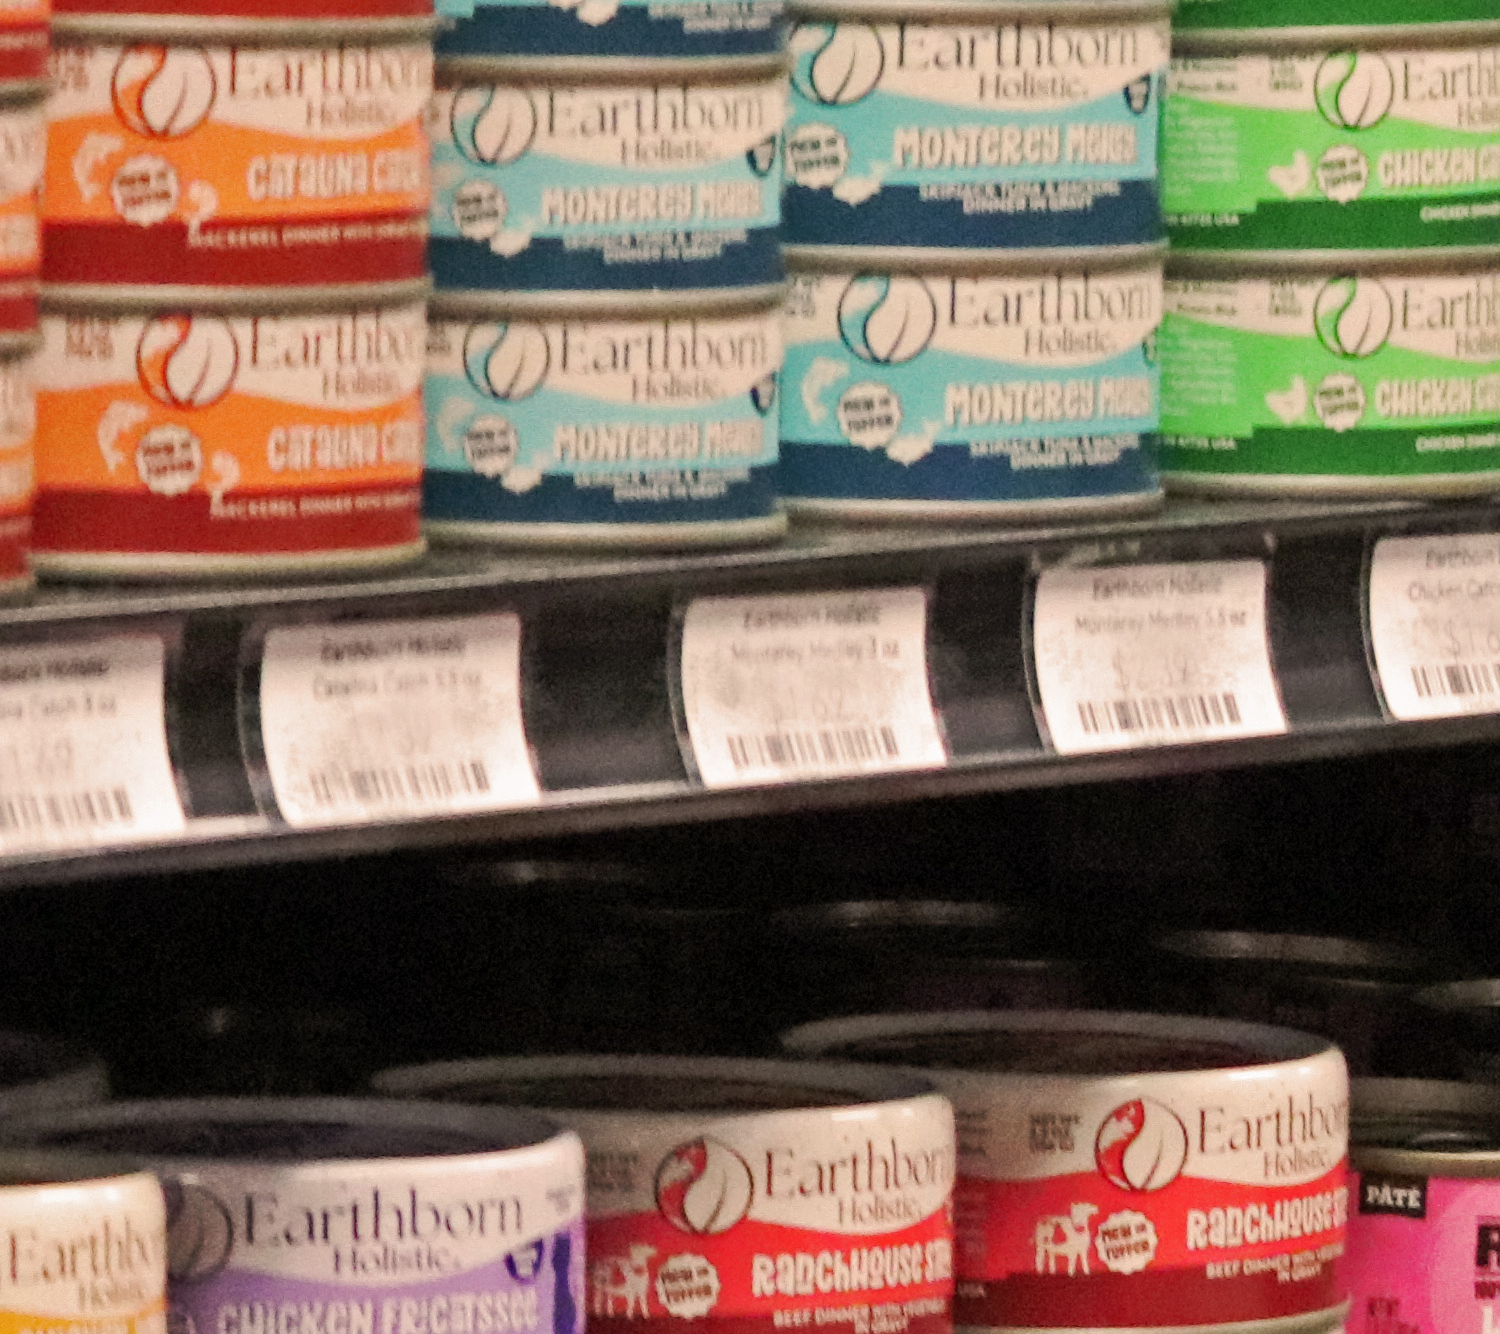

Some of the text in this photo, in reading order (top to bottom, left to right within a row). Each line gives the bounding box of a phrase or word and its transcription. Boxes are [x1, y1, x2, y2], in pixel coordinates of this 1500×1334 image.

[1366, 1182, 1421, 1209] PÂTÉ
[242, 1189, 524, 1249] Earthborn
[332, 1247, 456, 1278] Holistic
